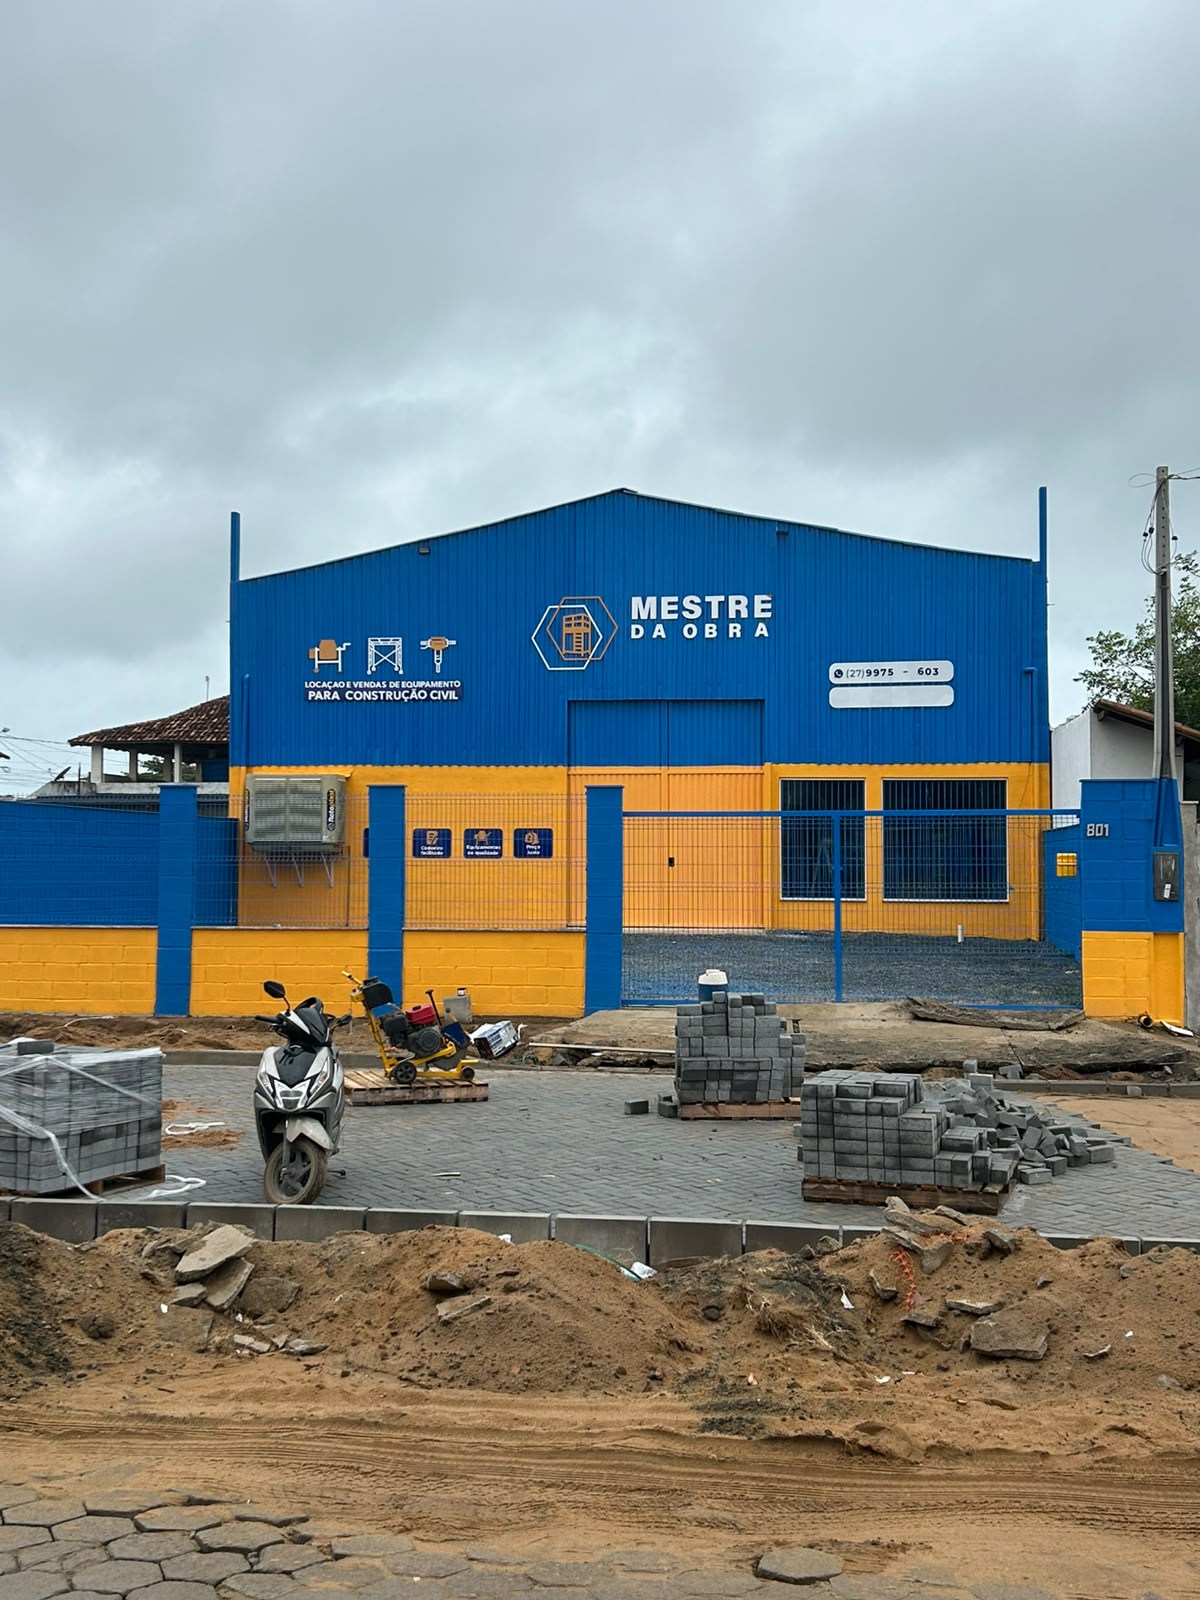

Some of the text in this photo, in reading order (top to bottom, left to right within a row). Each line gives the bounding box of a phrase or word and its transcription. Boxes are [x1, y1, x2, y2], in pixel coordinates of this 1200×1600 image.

[630, 594, 773, 620] MESTRE
[630, 622, 769, 639] DA OBRA
[917, 667, 939, 676] 603
[401, 680, 461, 688] EQUIPAMENTO
[308, 689, 459, 702] PARA CONSTRUÇÃO CIVIL
[1086, 823, 1109, 837] 801
